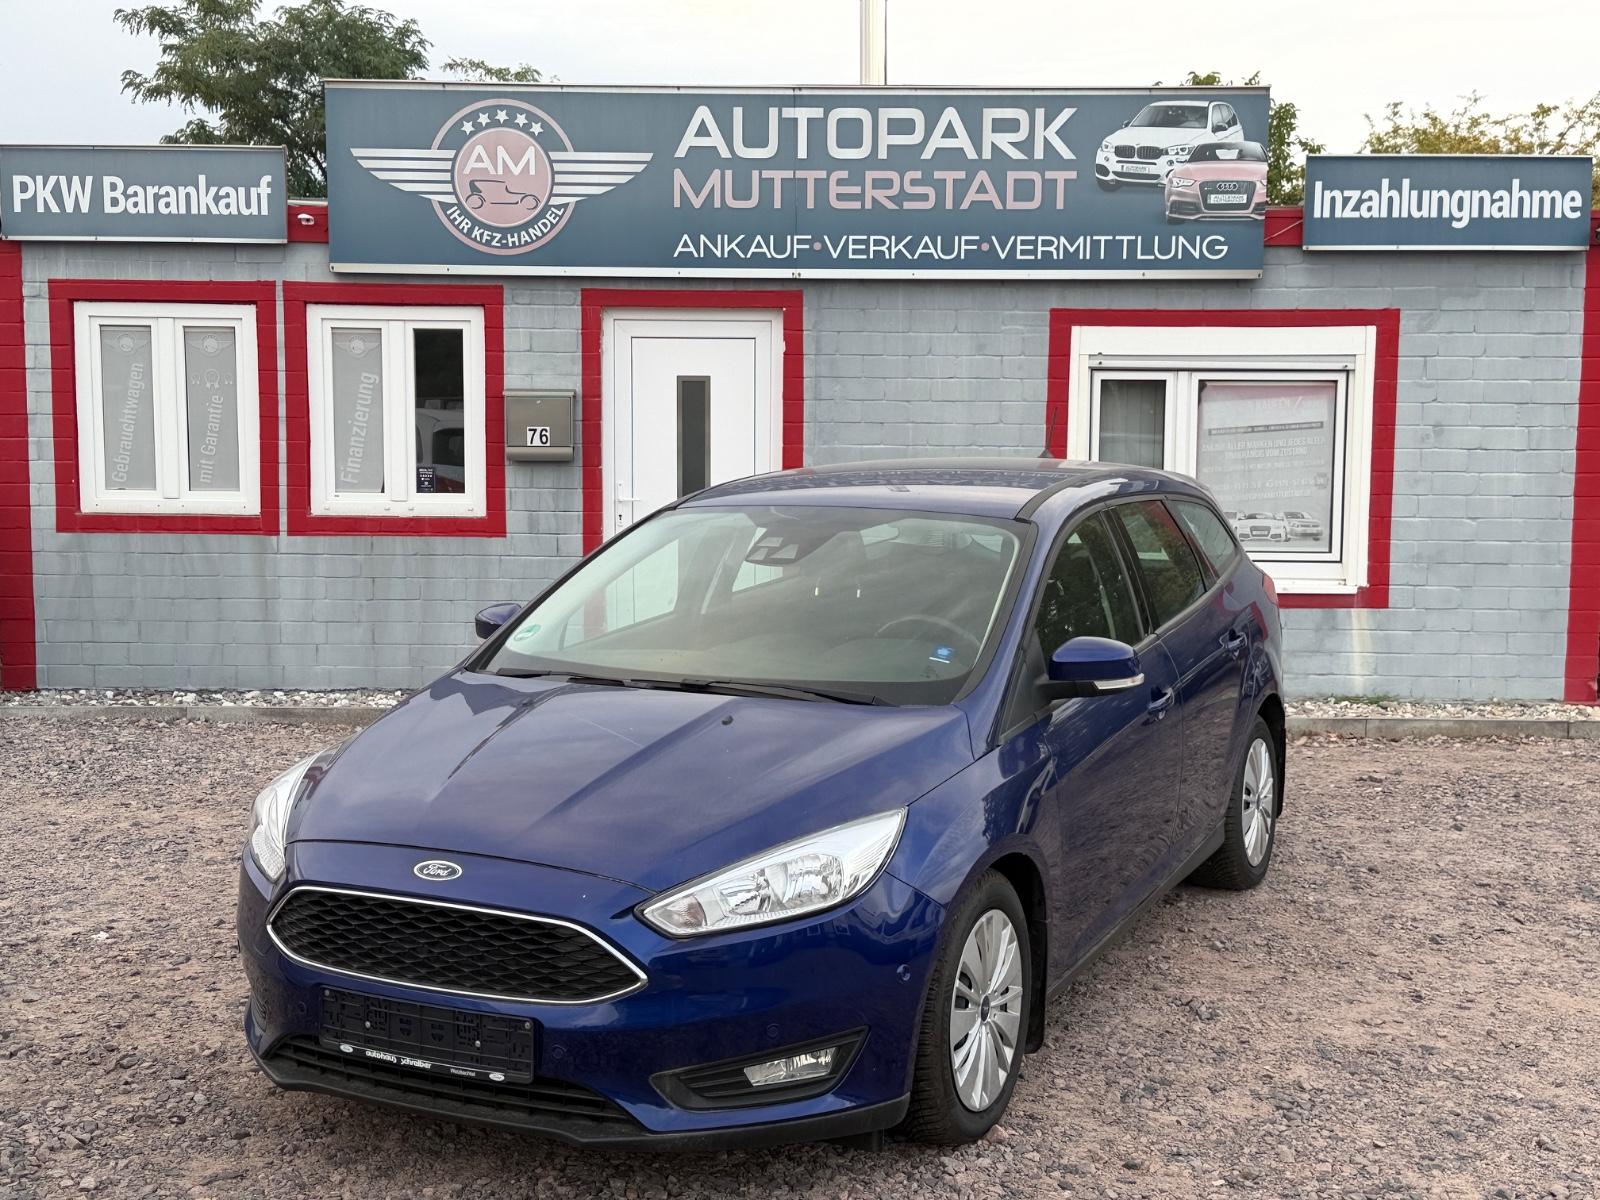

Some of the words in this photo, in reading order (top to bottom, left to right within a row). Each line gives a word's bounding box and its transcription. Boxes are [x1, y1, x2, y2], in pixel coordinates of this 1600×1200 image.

[673, 106, 1077, 160] AUTOPARK
[463, 145, 536, 176] AM
[11, 173, 94, 214] PKW
[103, 174, 272, 216] Barankauf
[672, 169, 1078, 210] MUTTERSTADT
[1313, 178, 1584, 229] Inzahlungnahme
[446, 205, 472, 234] IHR
[471, 206, 565, 247] KFZ-HANDEL
[990, 235, 1229, 262] VERMITTLUNG
[111, 361, 146, 484] Gebrauchtwagen
[200, 394, 224, 456] Garantie
[339, 371, 381, 485] Finanzierung
[528, 428, 549, 445] 76
[197, 458, 214, 484] mit
[423, 863, 452, 876] Ford
